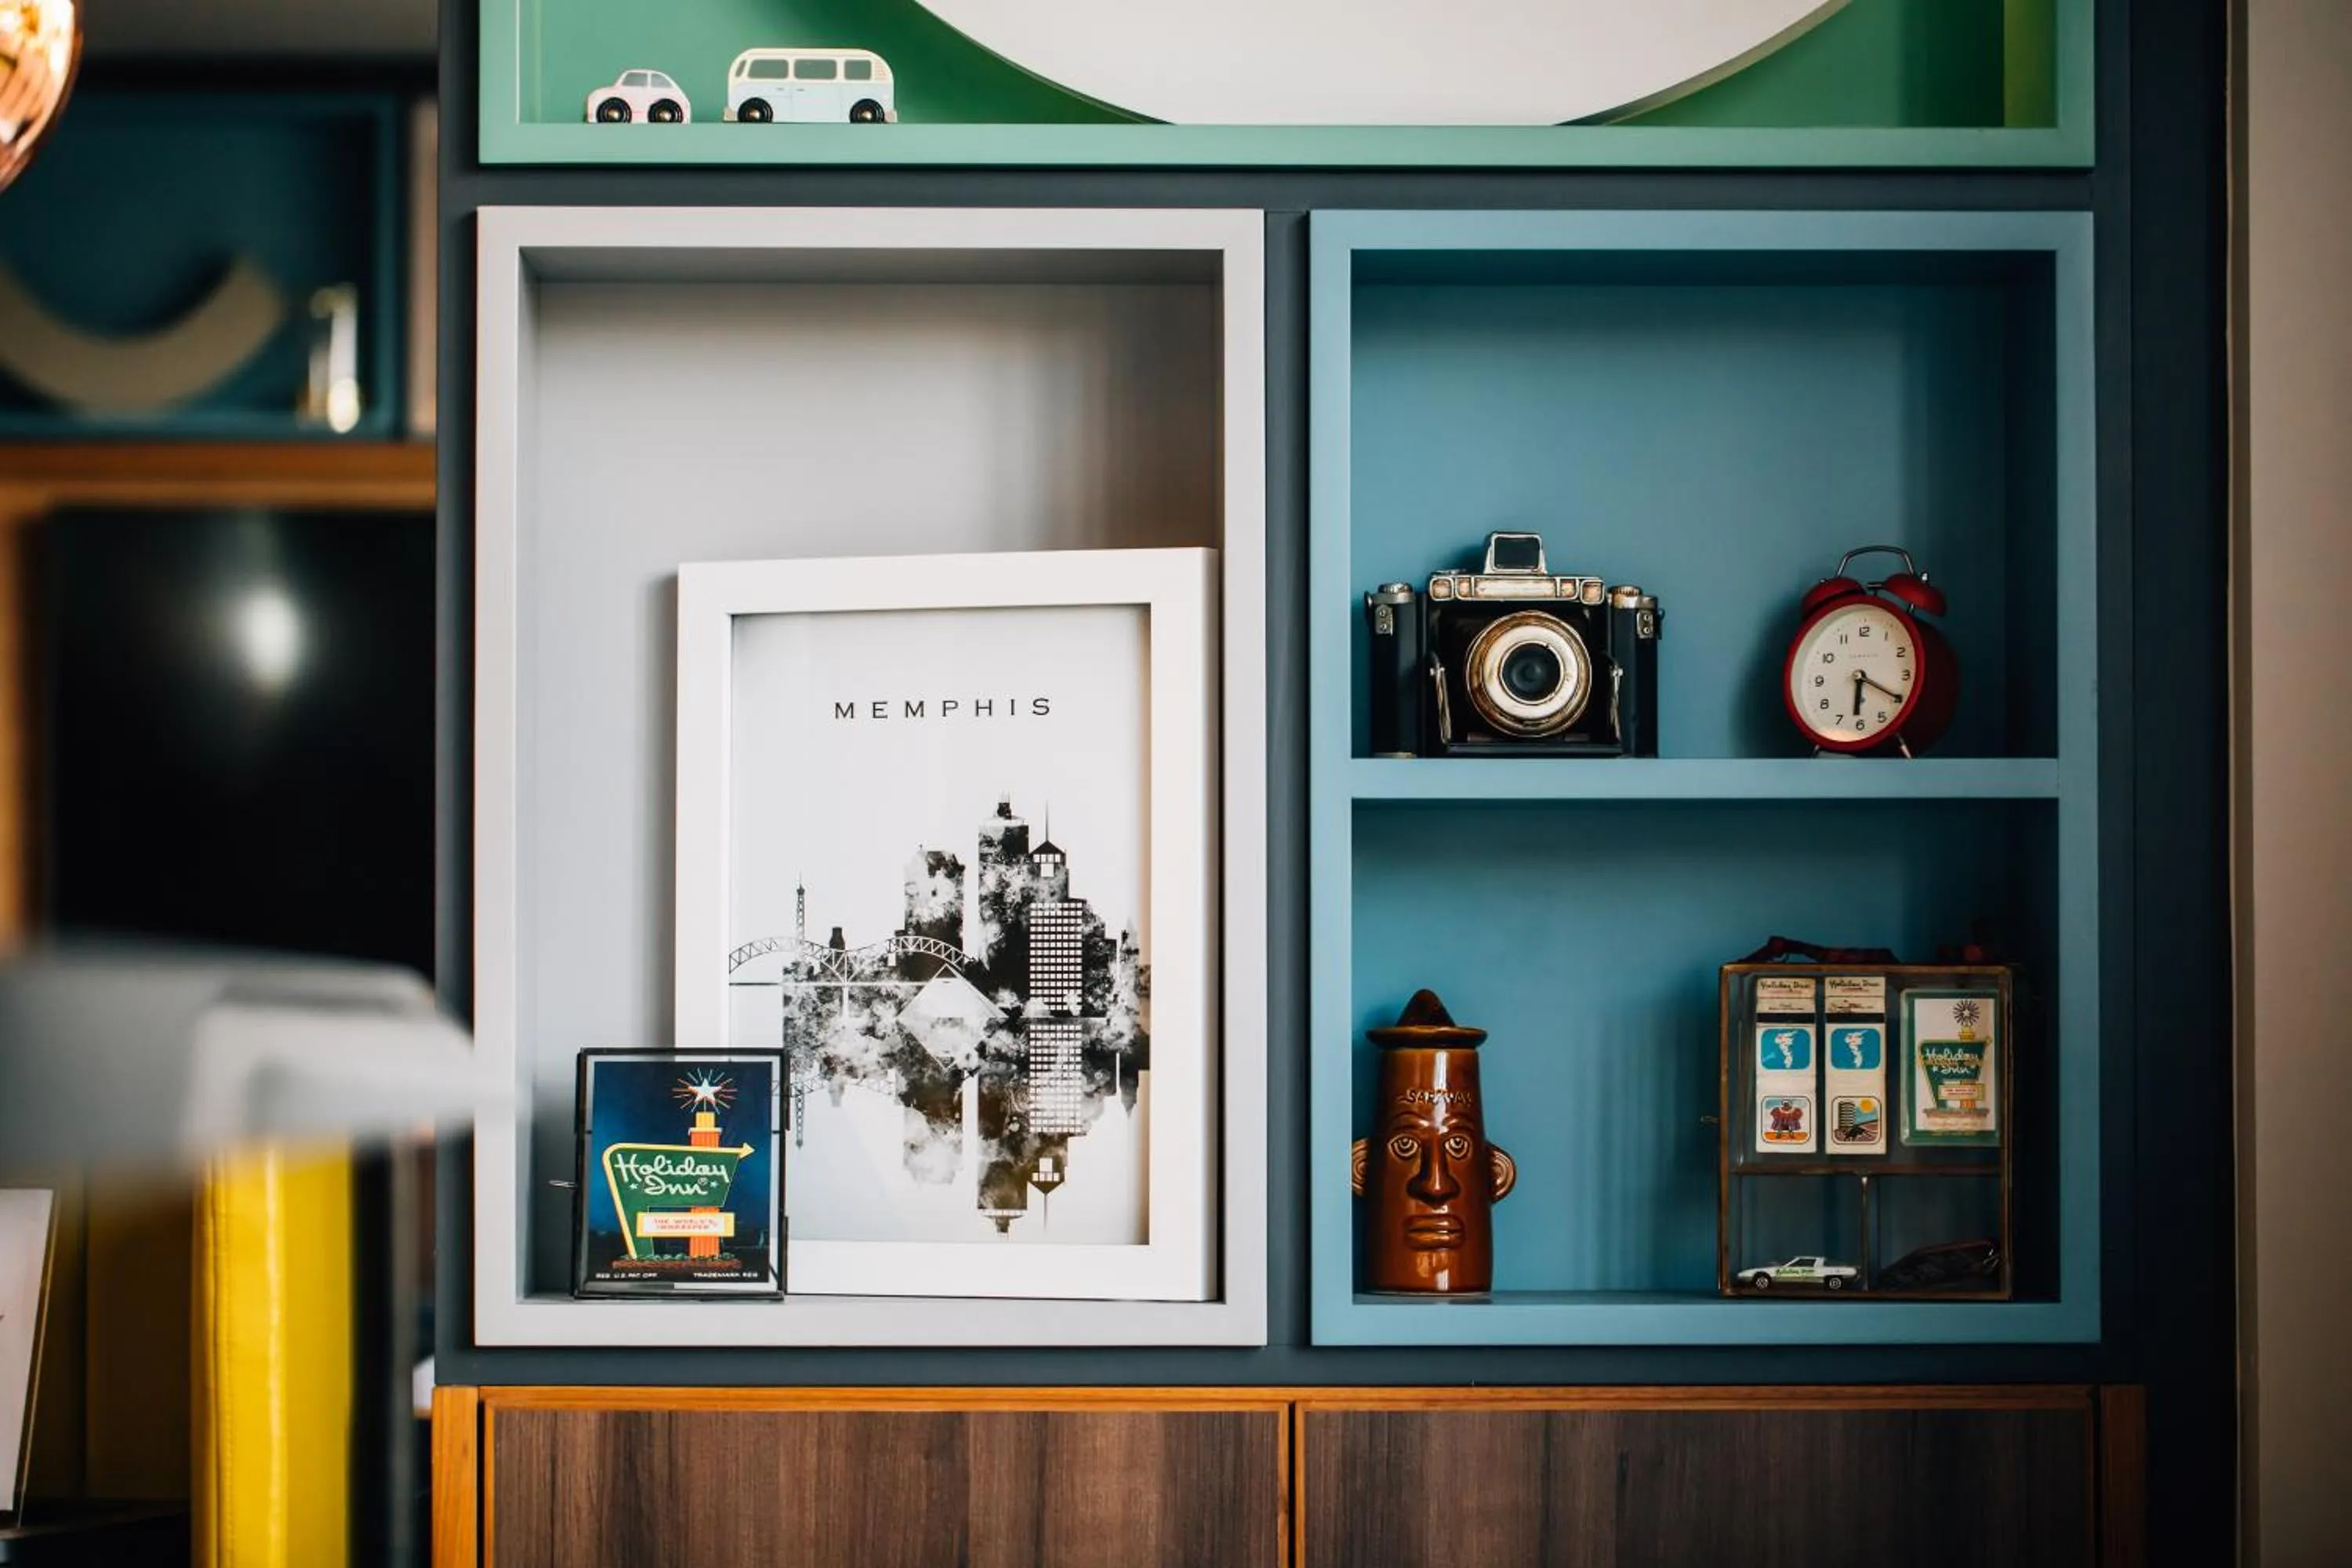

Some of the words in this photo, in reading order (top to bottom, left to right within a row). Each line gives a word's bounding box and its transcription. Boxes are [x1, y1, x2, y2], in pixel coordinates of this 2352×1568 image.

[1859, 626, 1870, 637] 12
[1840, 634, 1848, 644] 11
[1823, 652, 1835, 663] 10
[1896, 647, 1906, 657] 2
[1902, 670, 1911, 680] 3
[1815, 675, 1824, 687] 9
[834, 697, 1051, 719] MEMPHIS
[1820, 699, 1829, 709] 8
[1835, 714, 1844, 725] 7
[1878, 712, 1887, 723] 5
[1856, 720, 1864, 731] 6
[615, 1153, 729, 1182] Holiday
